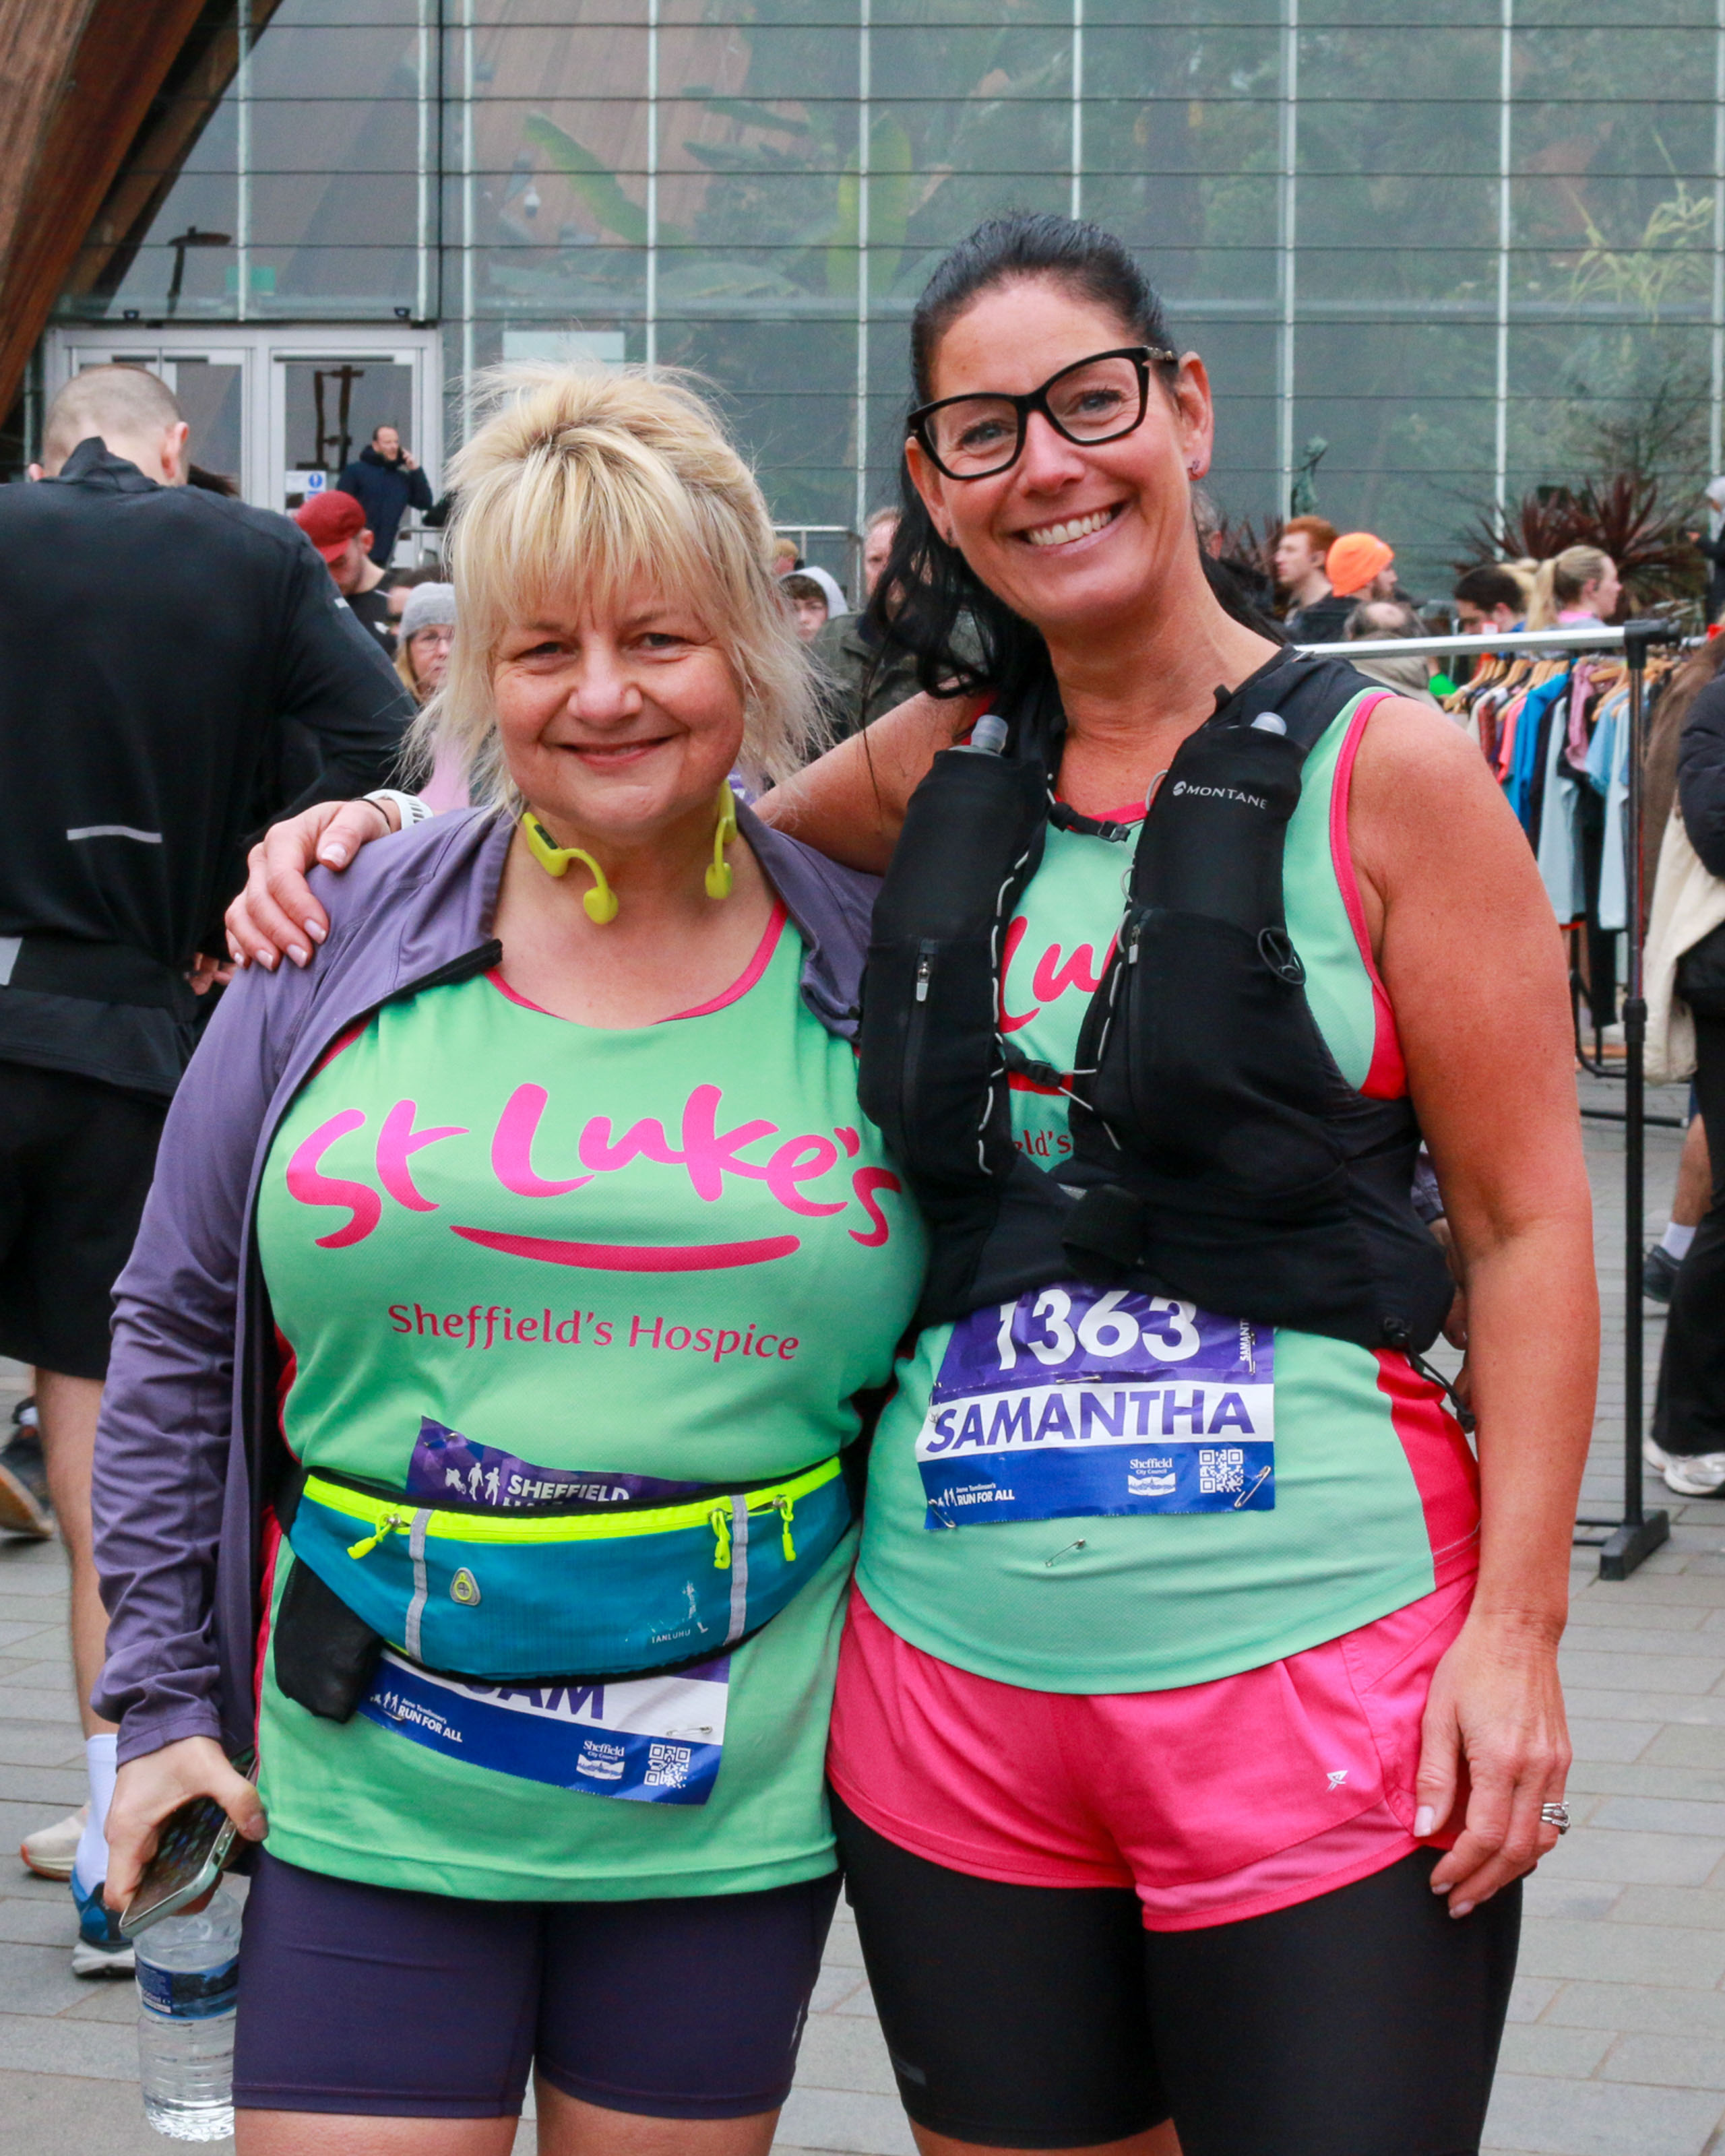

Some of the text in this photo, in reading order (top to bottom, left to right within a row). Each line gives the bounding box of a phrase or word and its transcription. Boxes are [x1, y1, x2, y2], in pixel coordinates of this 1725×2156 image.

[1186, 785, 1267, 810] MONTANE
[286, 1083, 902, 1248] St Luke's
[387, 1303, 800, 1363] Sheffield's Hospice
[997, 1288, 1201, 1371] 1363
[926, 1389, 1256, 1453] SAMANTHA
[1130, 1457, 1173, 1469] Sheffield
[507, 1474, 629, 1502] SHEFFIELD
[958, 1489, 1015, 1506] RUN FOR ALL
[398, 1705, 464, 1743] RUN FOR ALL
[583, 1740, 625, 1757] Sheffield
